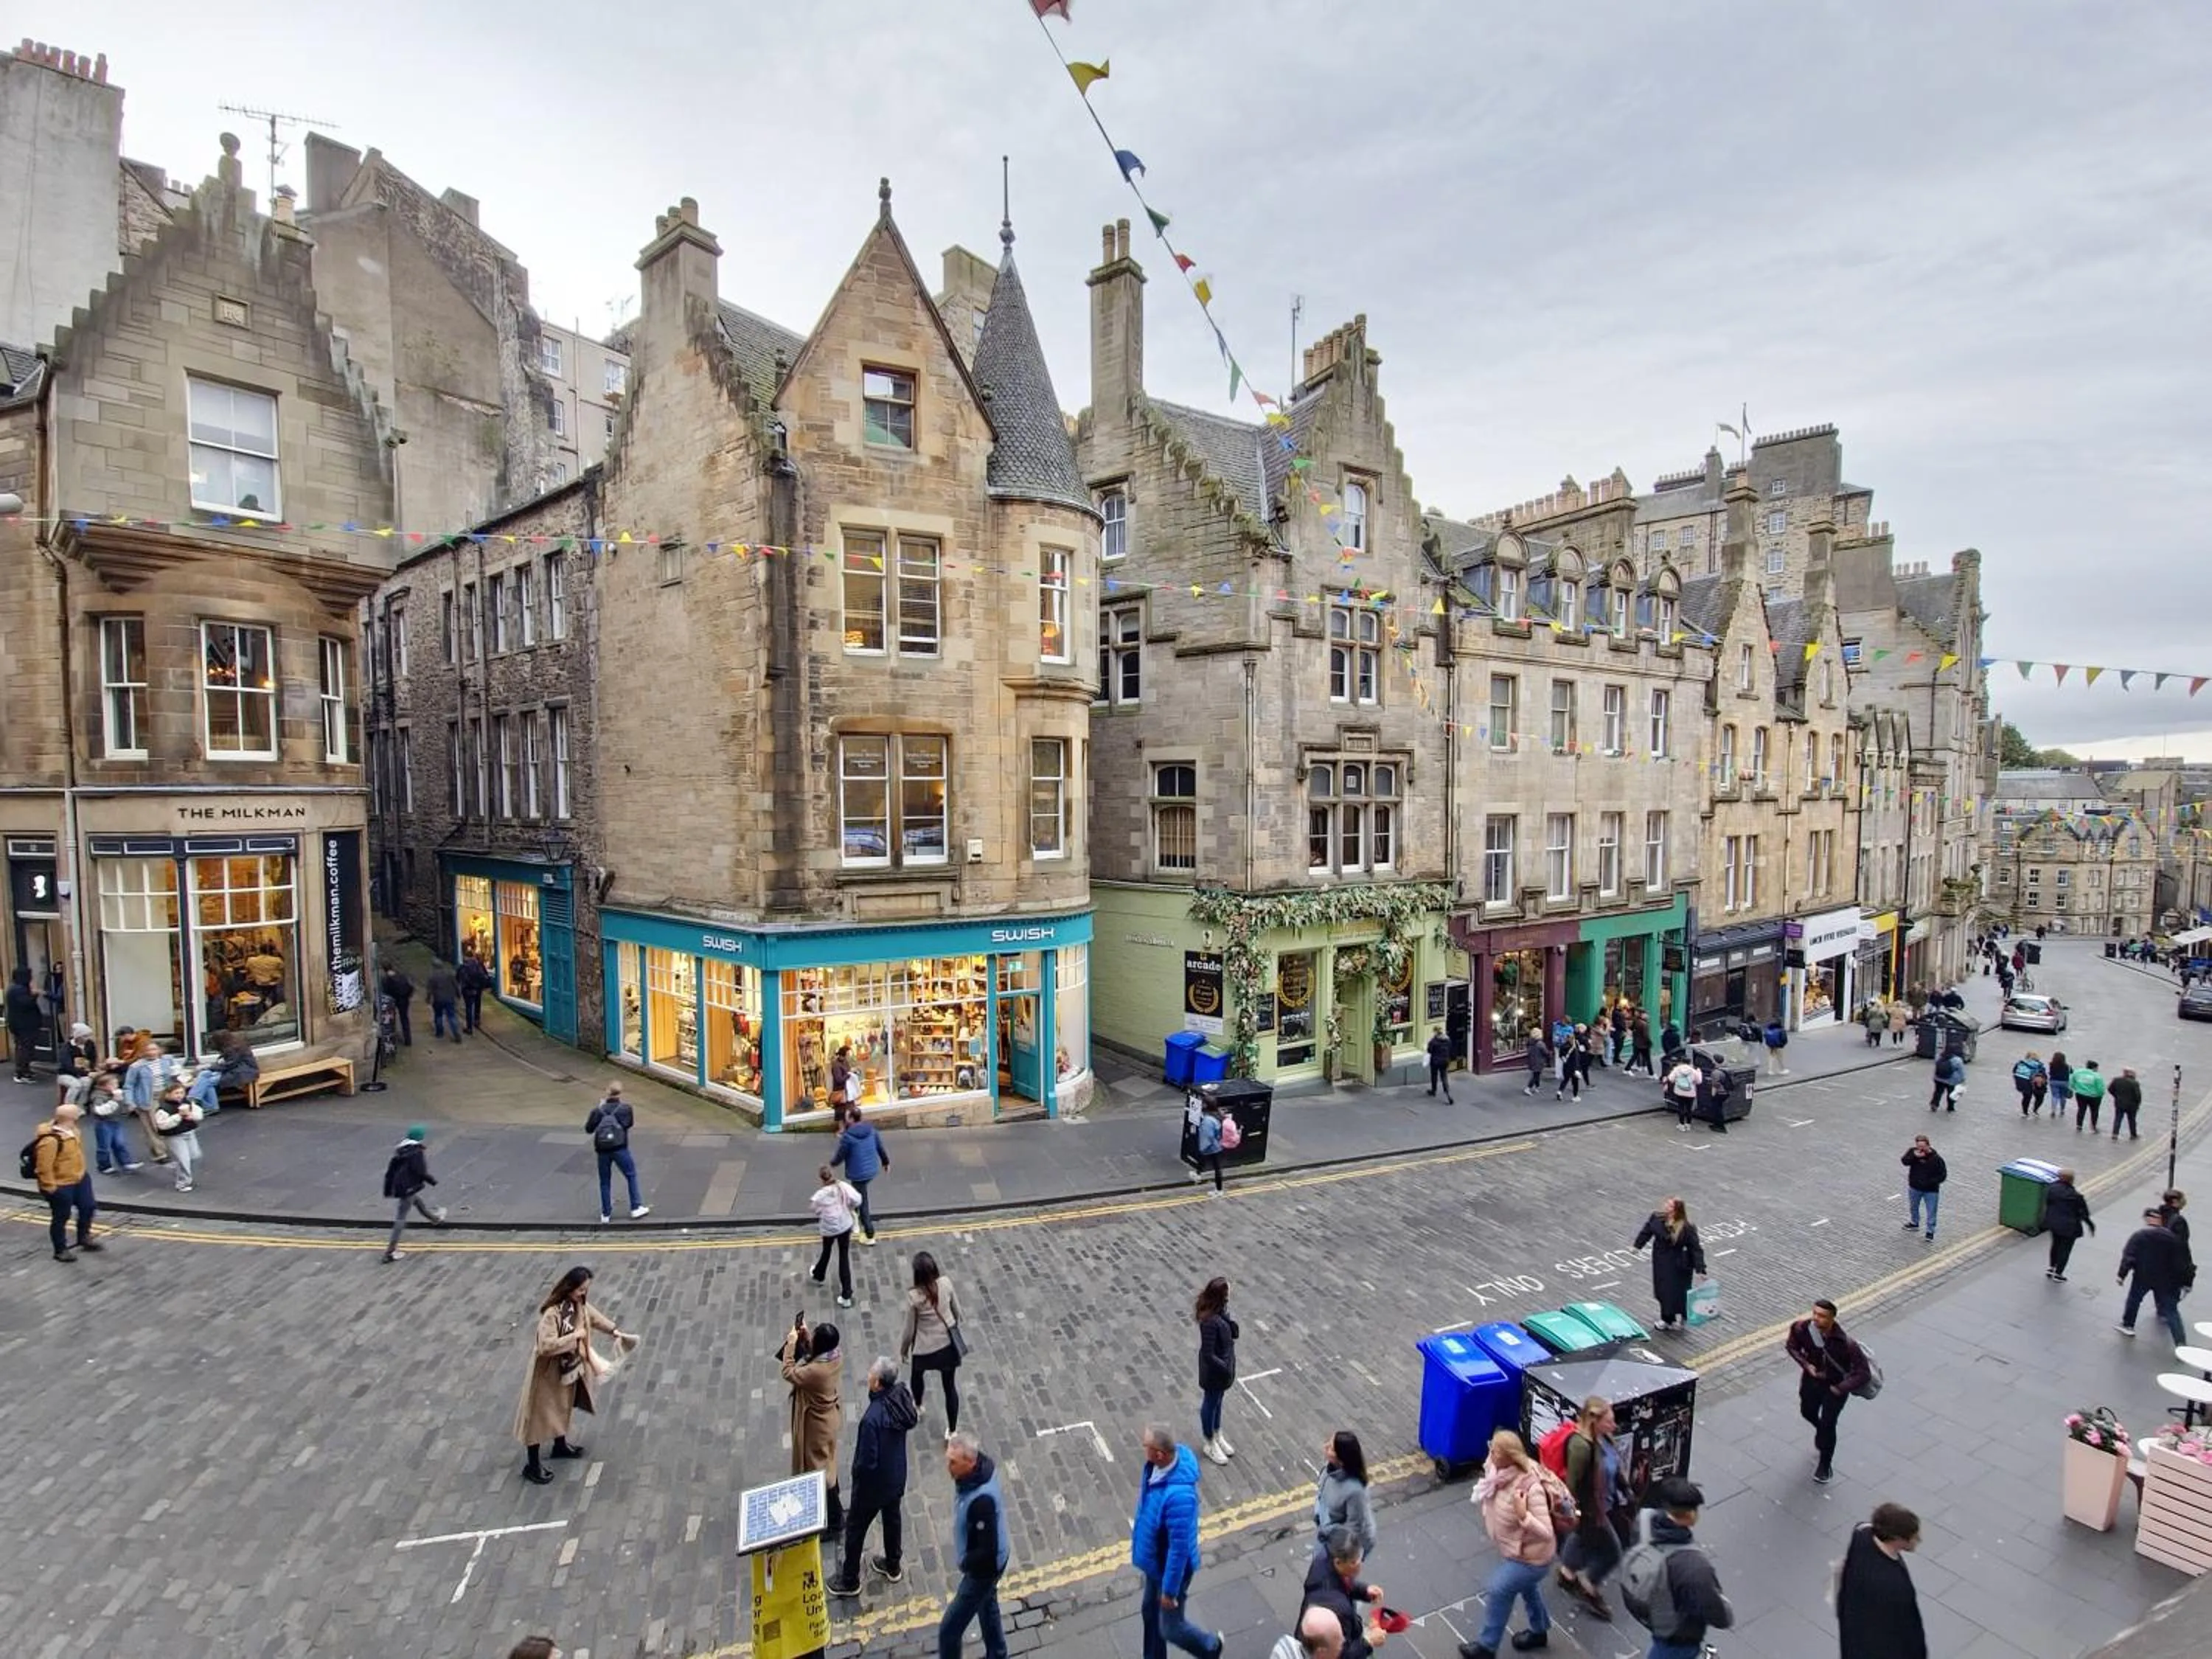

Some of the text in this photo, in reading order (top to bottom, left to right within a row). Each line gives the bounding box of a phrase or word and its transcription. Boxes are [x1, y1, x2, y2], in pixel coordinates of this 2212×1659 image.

[178, 807, 305, 818] THE MILKMAN
[326, 839, 343, 1011] www.themilkman.coffee
[992, 927, 1054, 942] SWISH
[702, 935, 742, 953] SWISH
[1186, 960, 1222, 971] arcade
[1554, 1242, 1652, 1279] LDERS
[1466, 1275, 1545, 1306] ONLY
